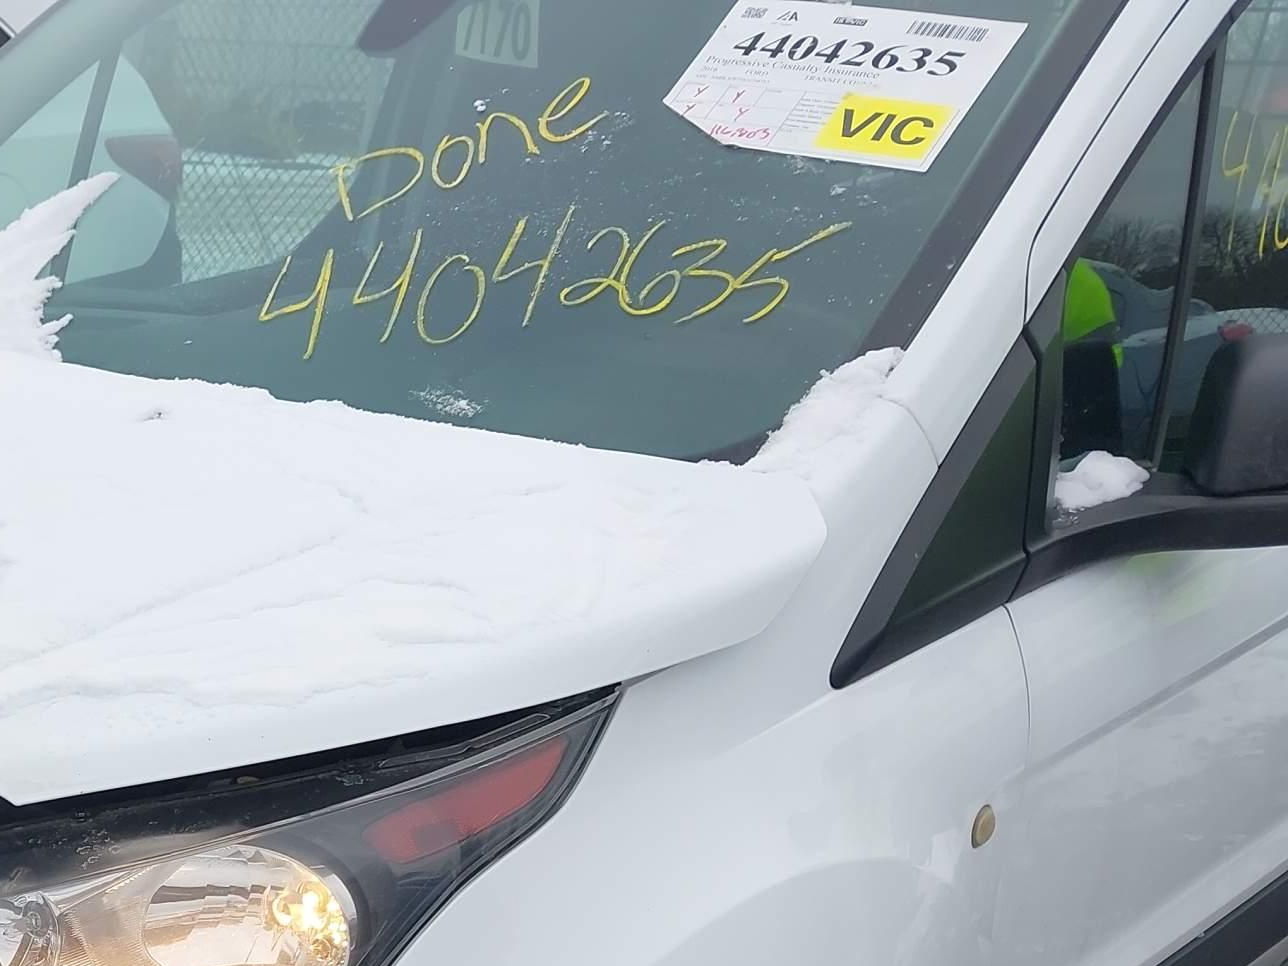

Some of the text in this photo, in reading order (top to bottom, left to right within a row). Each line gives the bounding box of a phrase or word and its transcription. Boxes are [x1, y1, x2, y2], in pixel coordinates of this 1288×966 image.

[705, 55, 881, 80] Progressive Casualty Insurance
[734, 31, 967, 76] 44042635
[329, 76, 608, 222] Done
[841, 108, 935, 146] VIC
[258, 205, 852, 361] 44042635
